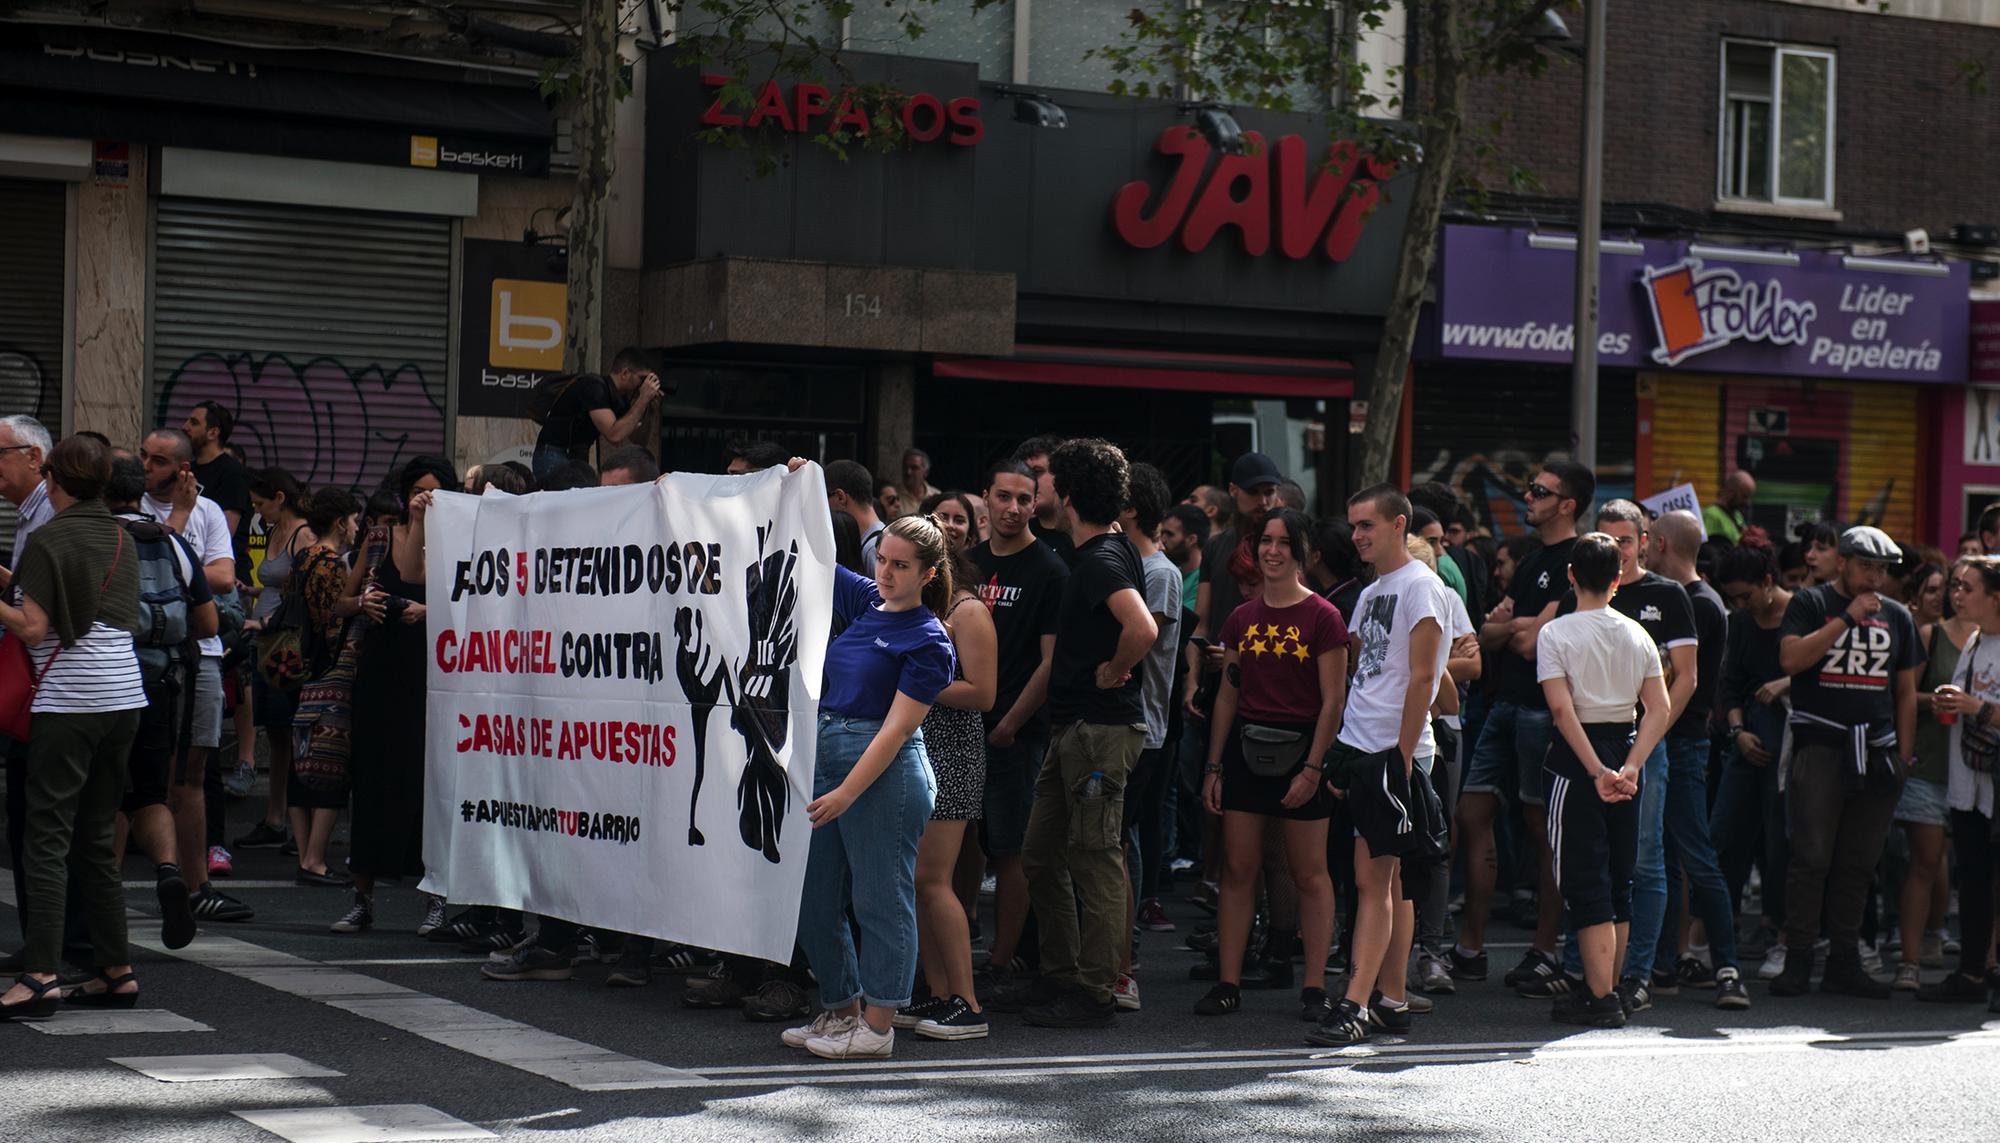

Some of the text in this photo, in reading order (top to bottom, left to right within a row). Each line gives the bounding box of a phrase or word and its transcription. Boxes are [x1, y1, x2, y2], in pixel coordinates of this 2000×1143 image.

[699, 75, 985, 146] ZAPAOS
[845, 293, 882, 319] 154
[1851, 317, 1888, 341] en
[1809, 336, 1942, 374] Papelería
[516, 551, 528, 597] 5
[560, 631, 663, 683] CONTRA
[1821, 647, 1891, 677] ZRZ
[457, 713, 677, 768] CASAS DE APUESTAS
